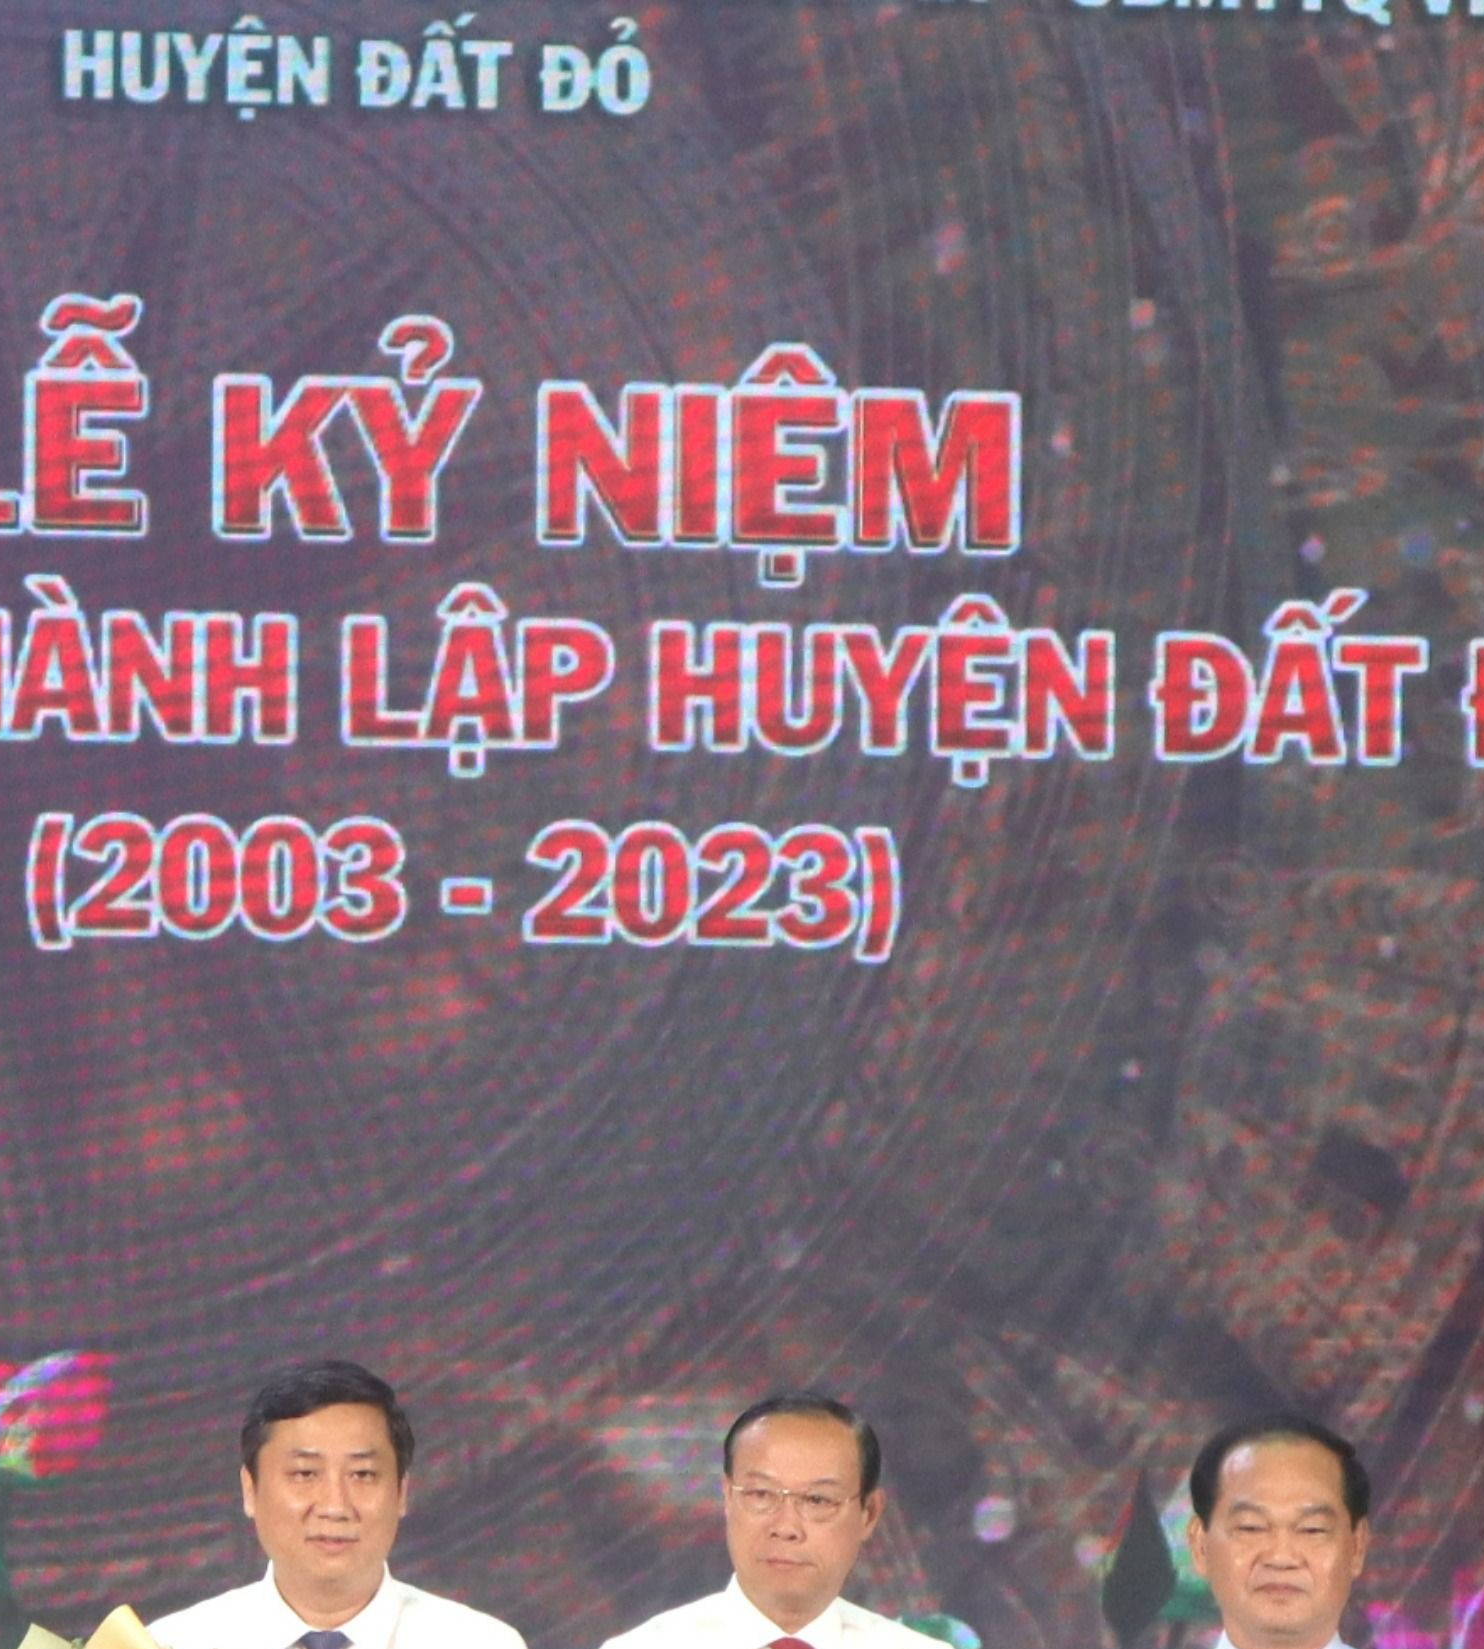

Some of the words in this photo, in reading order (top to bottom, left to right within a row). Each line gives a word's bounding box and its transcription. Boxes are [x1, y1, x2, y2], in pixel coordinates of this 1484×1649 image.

[63, 15, 330, 119] HUYỆN
[356, 12, 513, 110] ĐẤT
[538, 17, 652, 115] ĐỎ
[212, 316, 481, 542] KỶ
[537, 341, 1023, 589] NIỆM
[341, 583, 615, 778] LẬP
[648, 593, 1116, 789] HUYỆN
[1150, 588, 1428, 768] ĐẤT
[25, 812, 408, 950] (2003
[439, 875, 493, 917] -
[521, 818, 902, 966] 2023)
